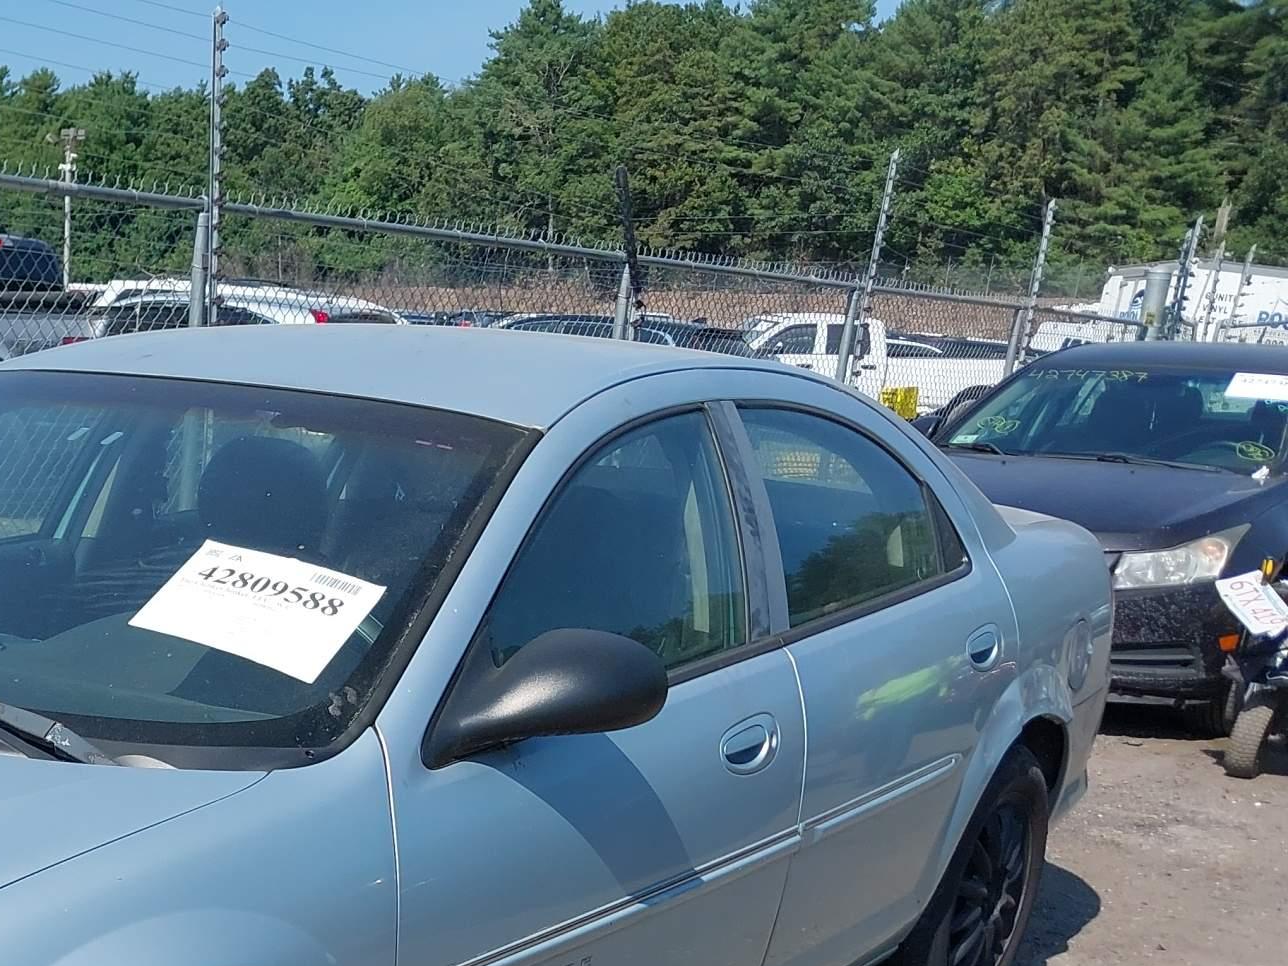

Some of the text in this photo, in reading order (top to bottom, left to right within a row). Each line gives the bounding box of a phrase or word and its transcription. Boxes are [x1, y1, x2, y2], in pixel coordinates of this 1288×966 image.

[1205, 291, 1237, 303] GUNIT
[1202, 303, 1228, 314] VNYL
[198, 564, 345, 617] 42809588
